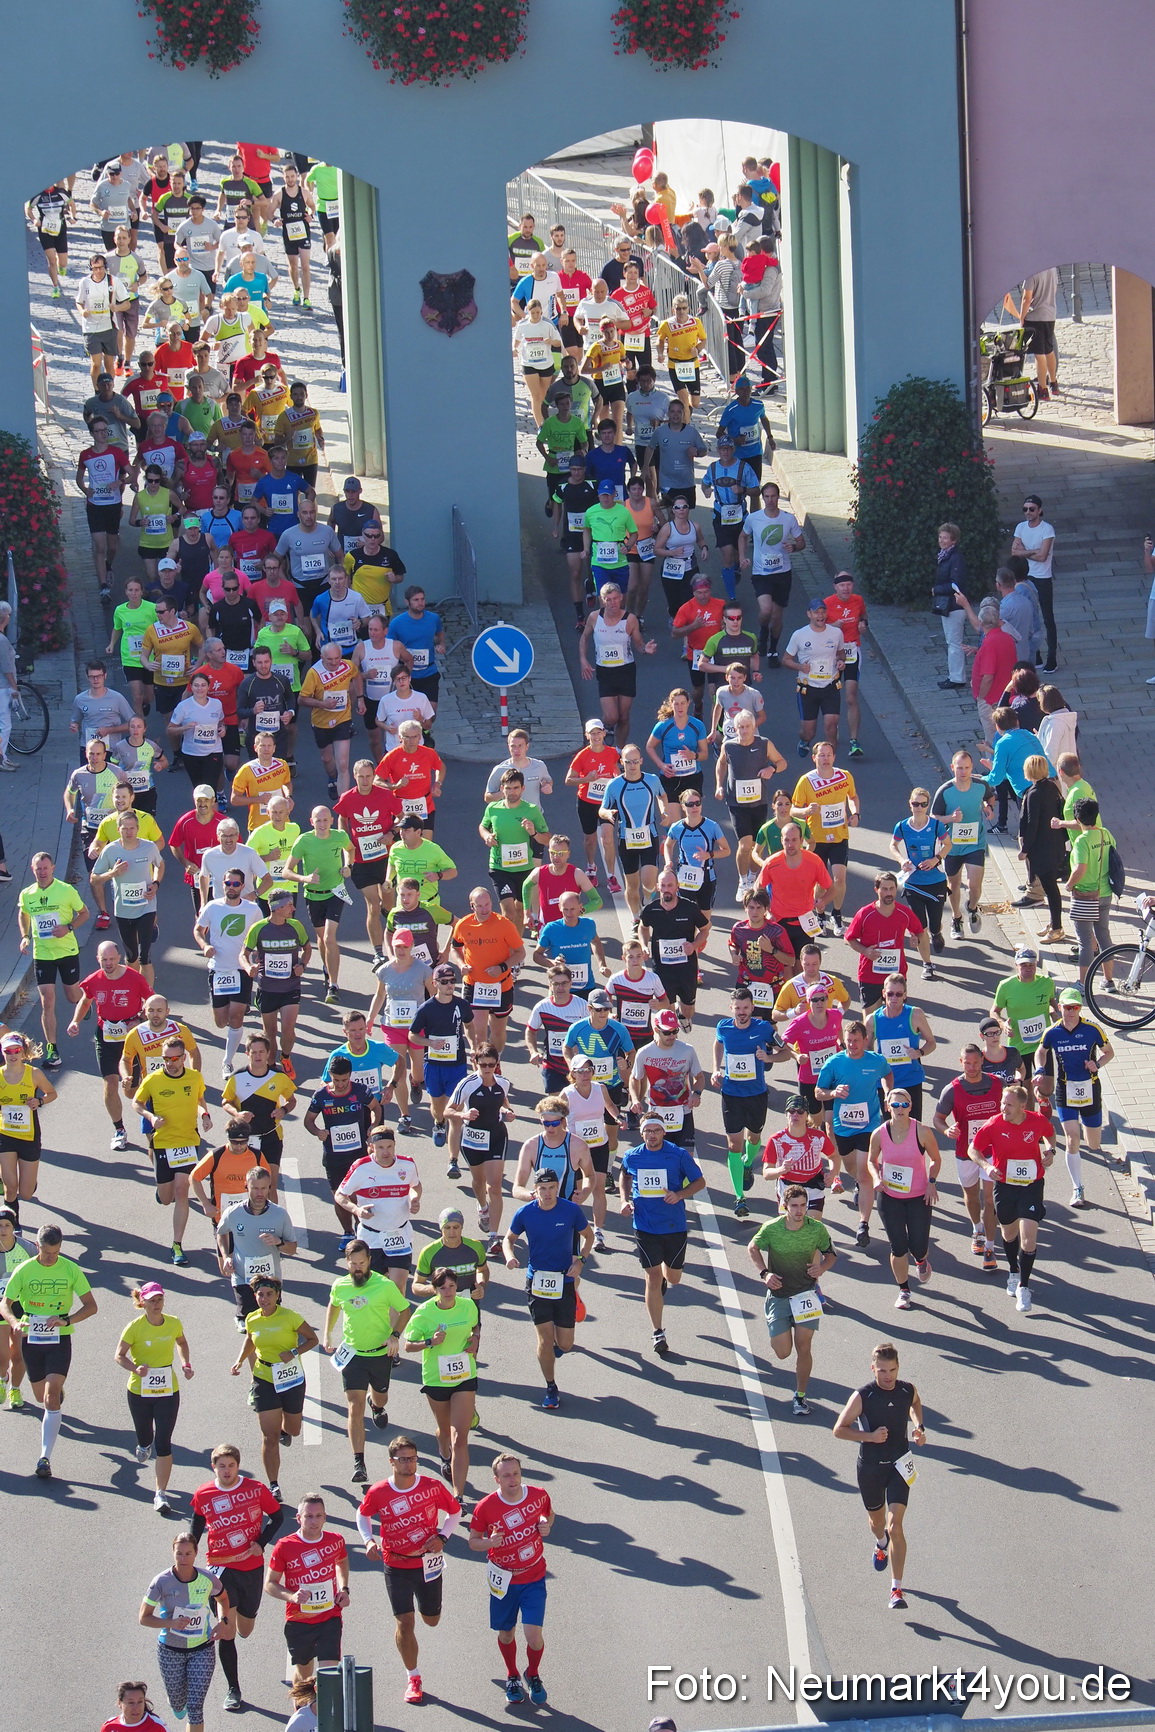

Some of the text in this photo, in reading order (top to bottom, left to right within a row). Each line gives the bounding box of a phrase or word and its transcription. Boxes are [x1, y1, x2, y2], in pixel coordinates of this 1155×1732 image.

[599, 548, 615, 556] 2138
[305, 559, 322, 568] 3126
[765, 558, 780, 566] 3049
[332, 627, 349, 635] 2491
[174, 631, 192, 641] BÖGL
[722, 647, 752, 655] BOCK
[259, 716, 276, 725] 2561
[197, 729, 214, 738] 2428
[256, 776, 270, 784] MAX
[592, 783, 606, 791] 302
[742, 786, 755, 794] 131
[815, 782, 849, 797] MAX BÖGL
[825, 810, 842, 818] 2397
[355, 823, 382, 832] adidas
[958, 828, 972, 836] 297
[631, 832, 645, 840] 160
[508, 850, 522, 858] 195
[683, 872, 697, 881] 161
[125, 889, 143, 897] 2287
[38, 919, 57, 928] 2290
[262, 939, 297, 947] BOCK
[559, 942, 588, 950] www.hasit.de
[663, 945, 683, 954] 2354
[269, 960, 288, 968] 2525
[877, 956, 897, 964] 2429
[217, 976, 235, 984] 2261
[478, 988, 498, 996] 3129
[753, 989, 767, 998] 127
[396, 1007, 411, 1015] 157
[625, 1008, 645, 1017] 2566
[1023, 1022, 1043, 1033] 3070
[144, 1043, 161, 1052] MAX
[891, 1045, 901, 1054] 82
[1057, 1043, 1088, 1052] BOCK
[736, 1061, 746, 1071] 43
[1075, 1088, 1085, 1096] 38
[323, 1103, 361, 1115] MENSCH
[8, 1112, 23, 1121] 142
[664, 1112, 675, 1121] 42
[843, 1110, 864, 1119] 2479
[466, 1129, 485, 1138] 3062
[583, 1126, 597, 1136] 226
[336, 1131, 357, 1141] 3066
[173, 1147, 189, 1156] 230
[892, 1171, 903, 1181] 95
[1016, 1167, 1027, 1176] 96
[644, 1176, 660, 1186] 319
[384, 1236, 404, 1247] 2320
[250, 1263, 270, 1274] 2263
[539, 1279, 556, 1288] 130
[800, 1299, 813, 1310] 76
[33, 1323, 55, 1332] 2322
[447, 1361, 463, 1372] 153
[277, 1366, 298, 1380] 2552
[149, 1375, 165, 1385] 294
[309, 1590, 327, 1601] 112
